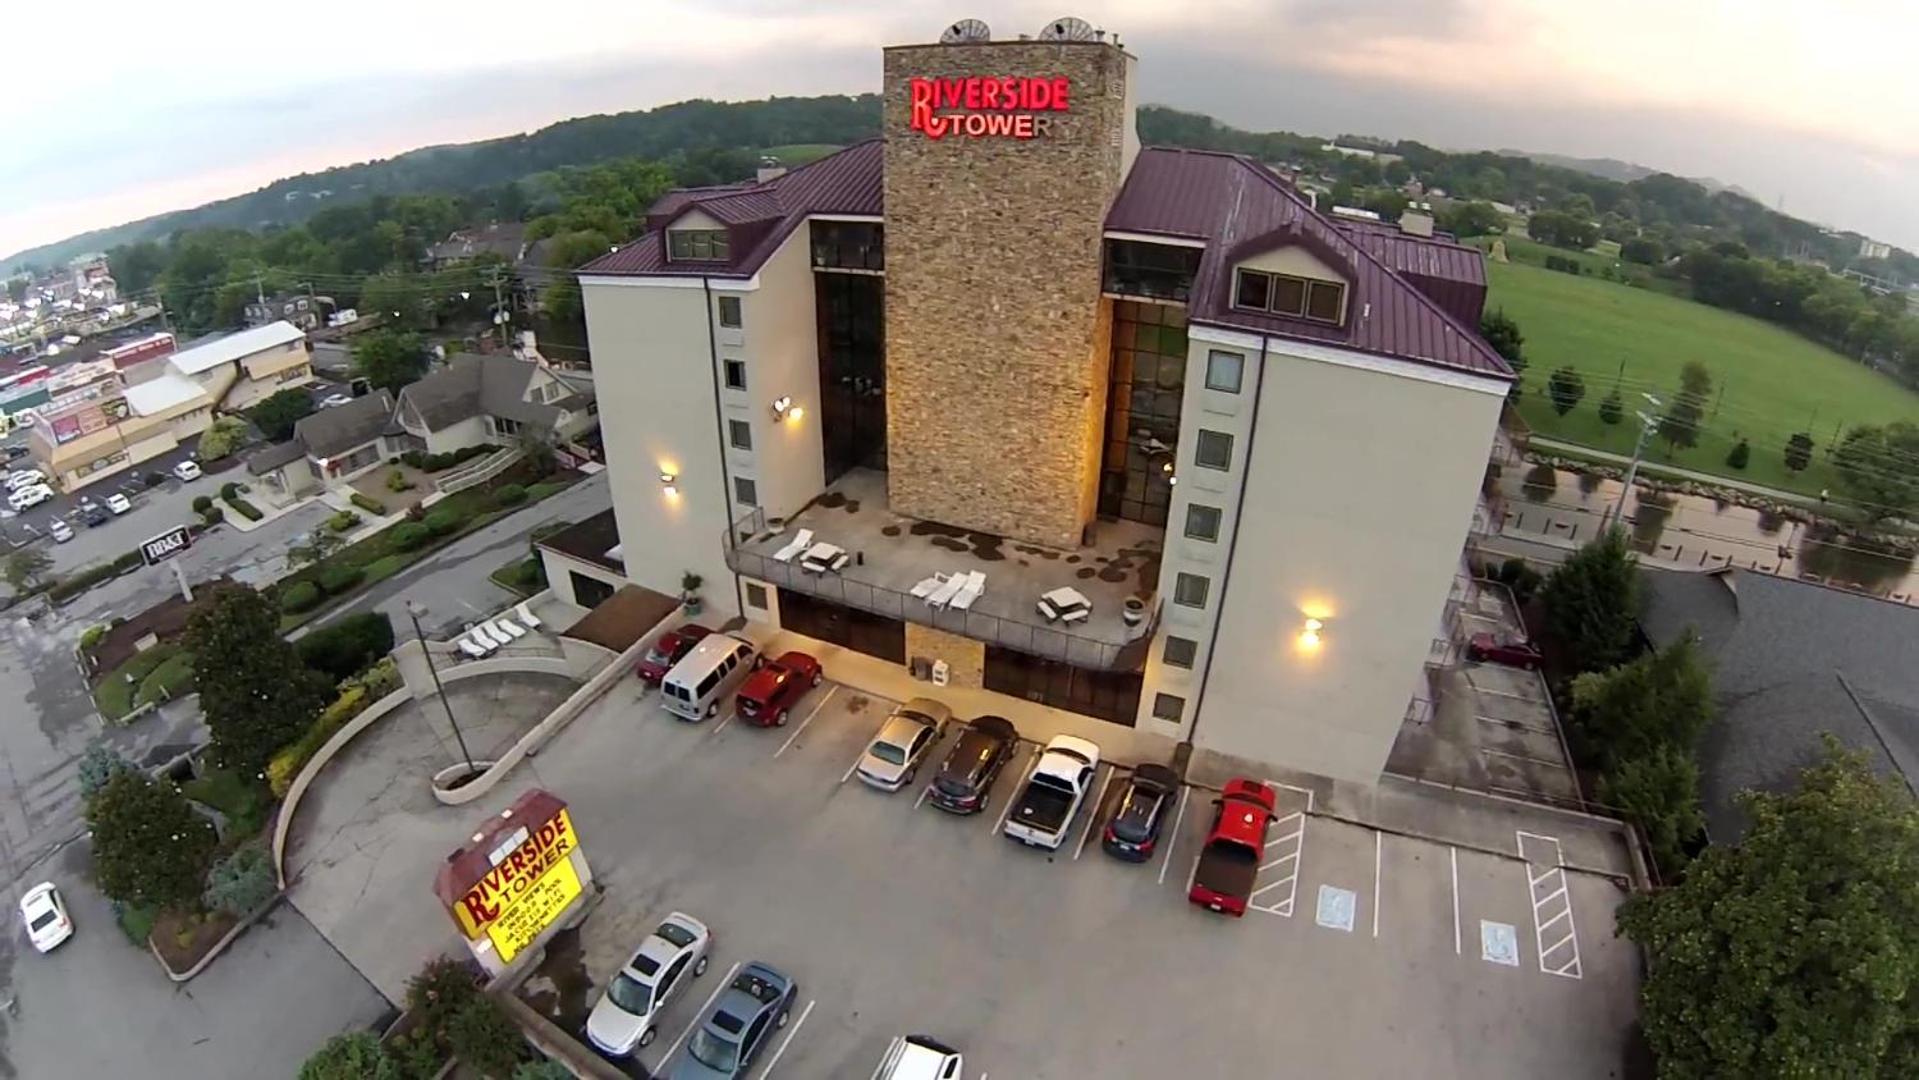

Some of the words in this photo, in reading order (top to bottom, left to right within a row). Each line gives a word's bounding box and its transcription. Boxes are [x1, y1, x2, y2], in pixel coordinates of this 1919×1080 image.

[910, 76, 1069, 139] RIVERSIDE
[946, 113, 1050, 138] TOWER
[462, 814, 566, 928] RIVERSIDE
[500, 838, 570, 902] TOWER
